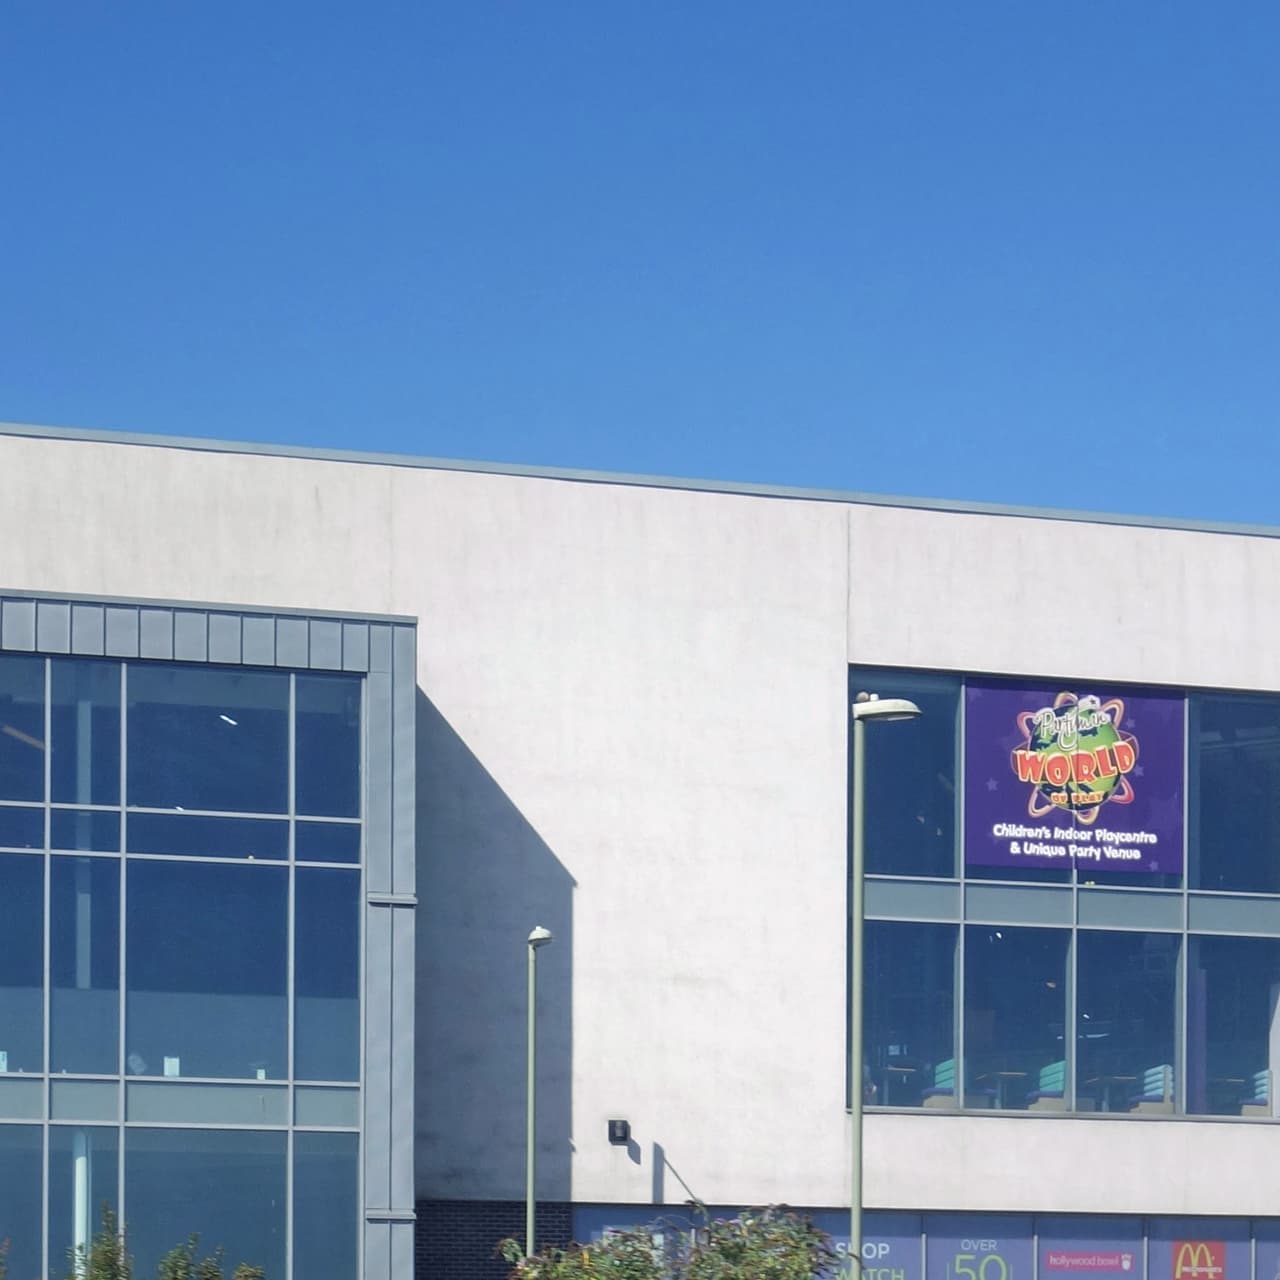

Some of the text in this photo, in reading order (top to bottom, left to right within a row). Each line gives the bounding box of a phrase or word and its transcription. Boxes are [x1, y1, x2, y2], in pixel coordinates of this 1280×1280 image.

[1016, 742, 1136, 786] WORLD
[993, 822, 1157, 844] Children's Indoor Playcentre
[1010, 842, 1141, 861] & Unique Party Venue
[961, 1240, 997, 1251] OVER
